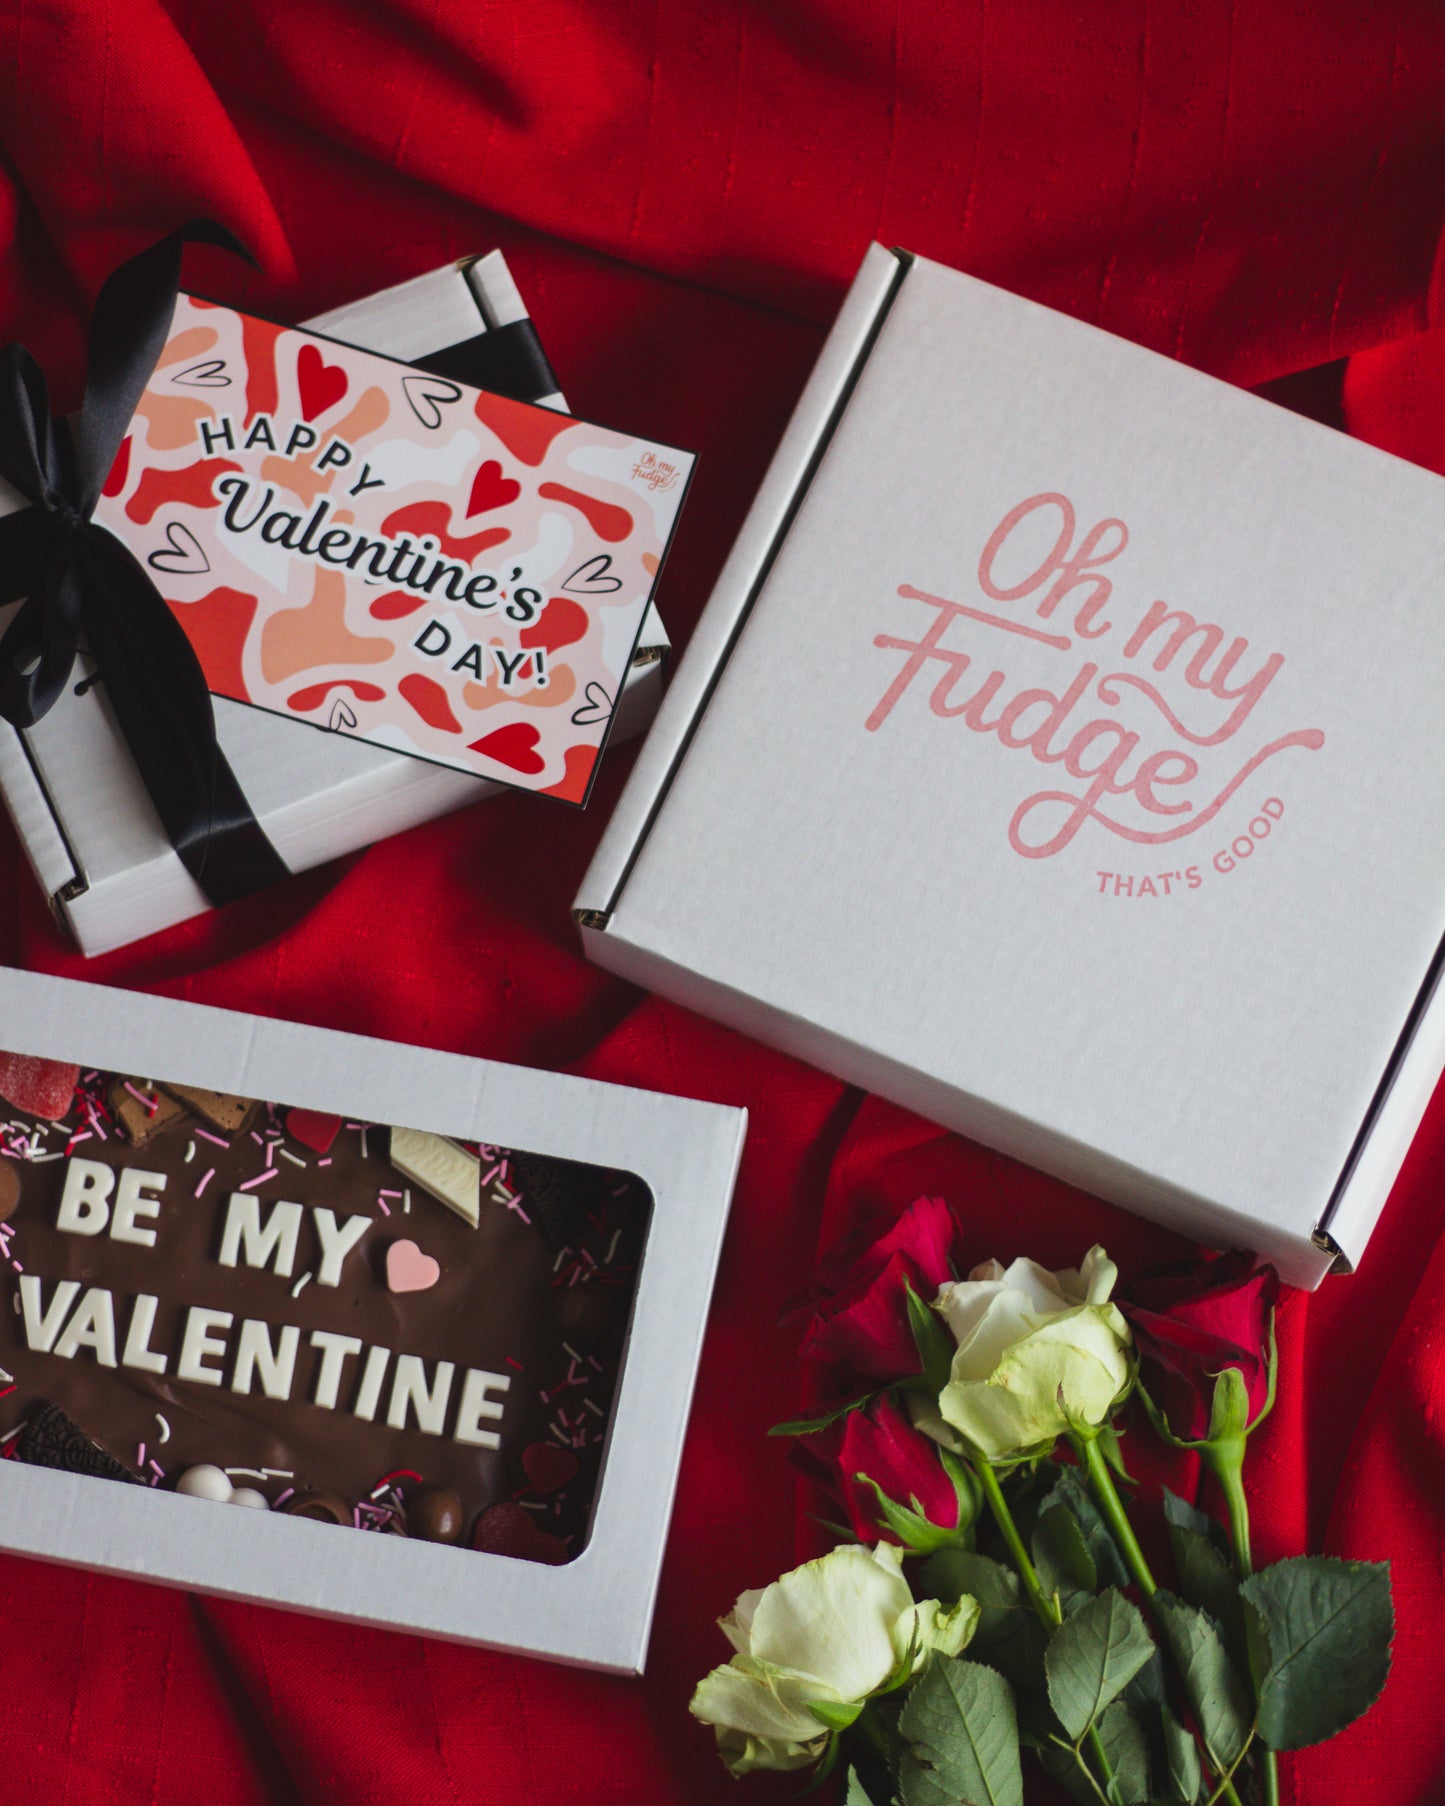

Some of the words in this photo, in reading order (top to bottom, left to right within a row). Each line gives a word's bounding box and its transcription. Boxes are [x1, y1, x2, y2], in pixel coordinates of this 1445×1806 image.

[201, 417, 386, 497] HAPPY
[219, 478, 543, 622] Valentine's
[413, 620, 547, 686] DAY!
[978, 492, 1129, 639] Oh
[1098, 600, 1285, 747] my
[865, 584, 1325, 859] Fudge
[1096, 866, 1203, 898] THAT'S
[1213, 797, 1285, 874] GOOD
[56, 1157, 168, 1248] BE
[218, 1192, 373, 1287] MY
[19, 1275, 511, 1450] VALENTINE
